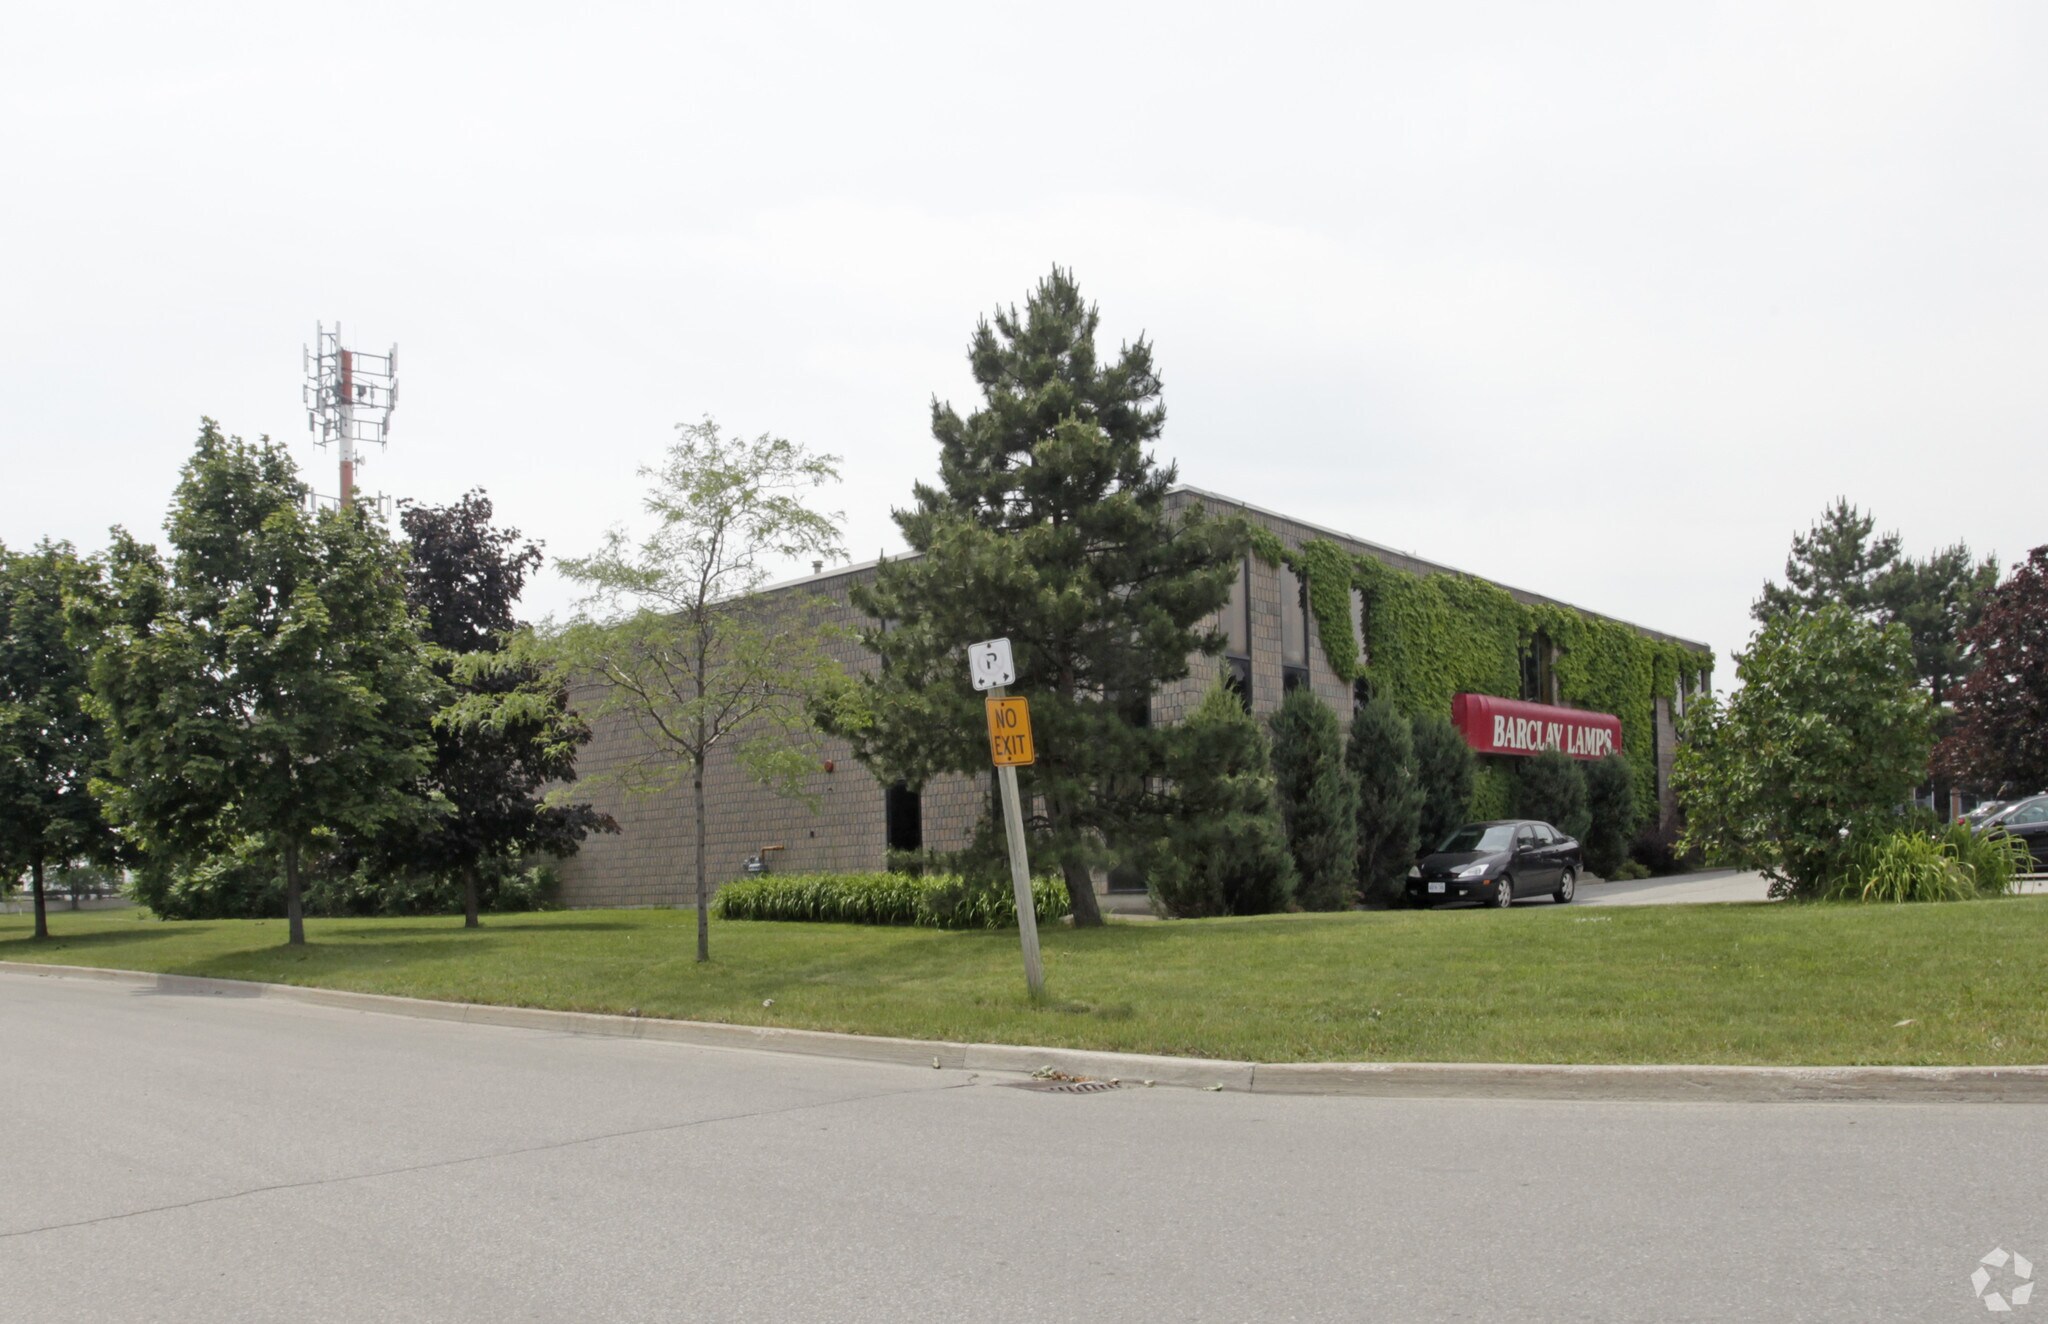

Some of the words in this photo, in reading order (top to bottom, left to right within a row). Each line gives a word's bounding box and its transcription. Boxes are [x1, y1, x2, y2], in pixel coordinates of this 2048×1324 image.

[995, 708, 1018, 728] NO
[994, 734, 1025, 756] EXIT
[1493, 714, 1563, 753] BARCLAY
[1567, 724, 1612, 757] LAMPS
